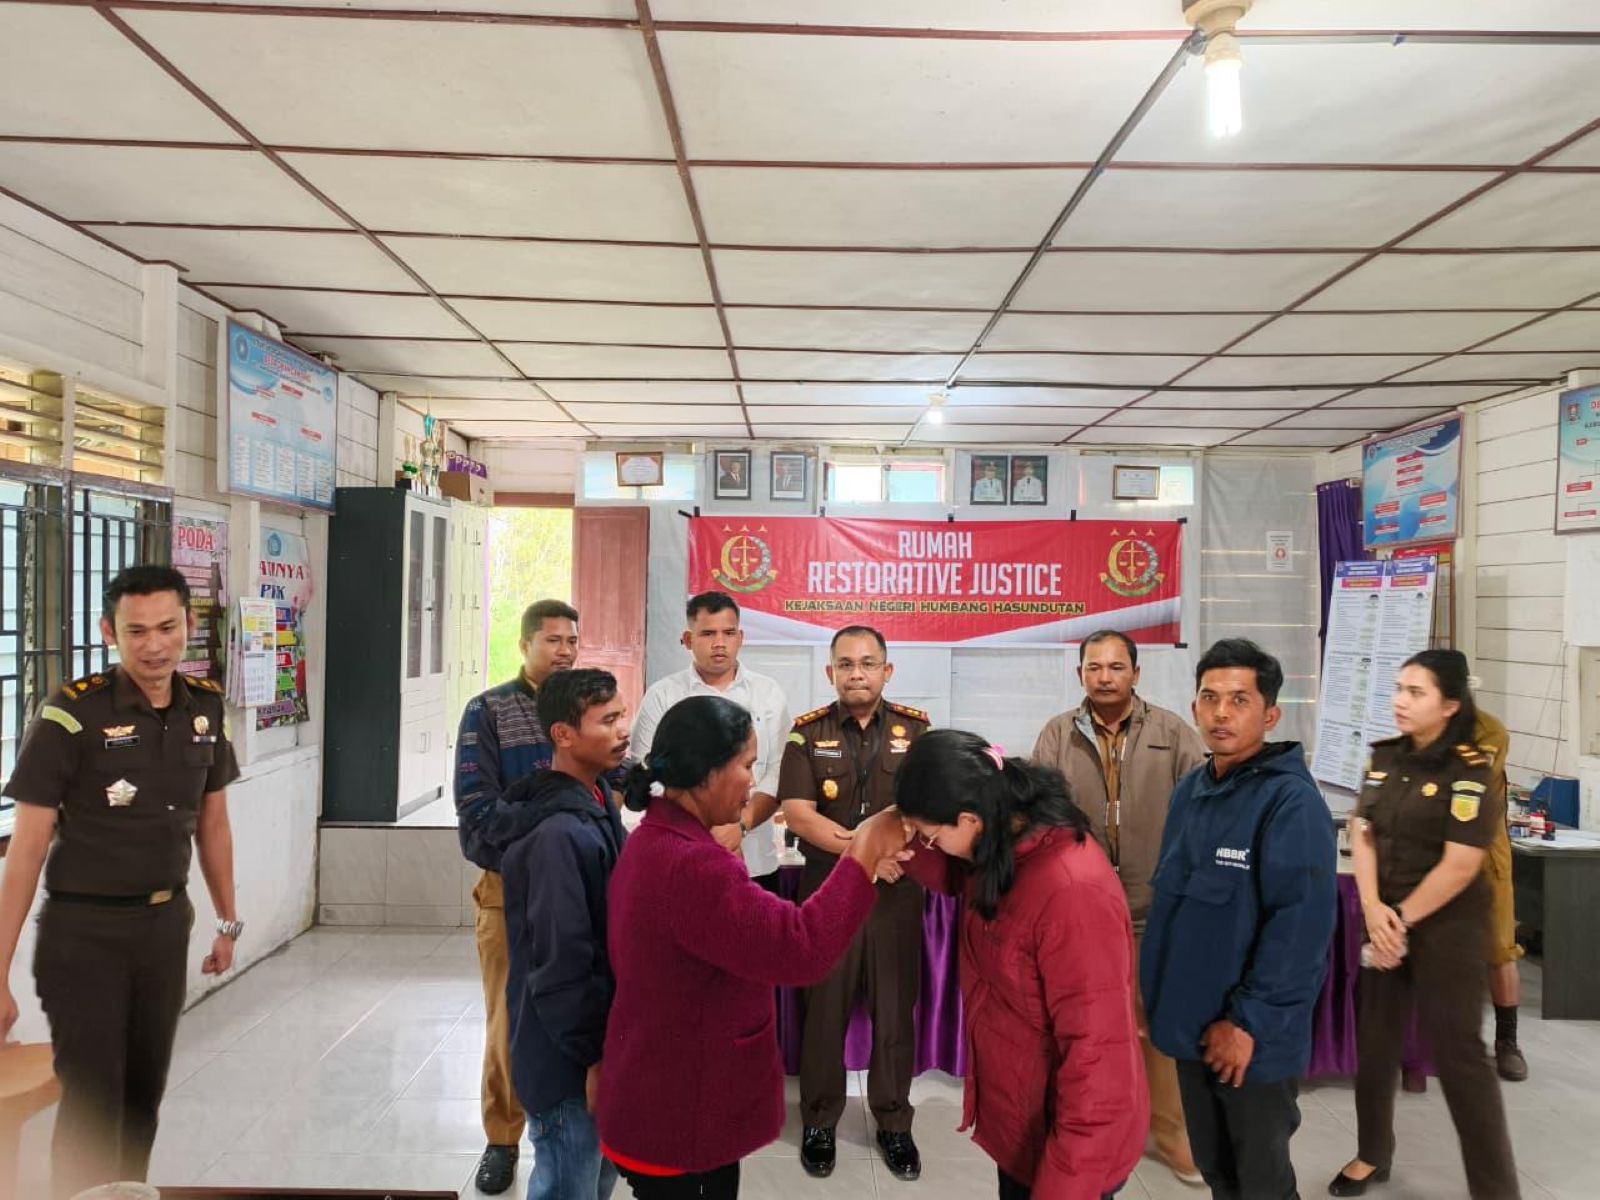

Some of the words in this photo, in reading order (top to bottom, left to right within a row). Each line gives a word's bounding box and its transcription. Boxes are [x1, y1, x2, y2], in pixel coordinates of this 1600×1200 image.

[177, 526, 214, 550] PODA
[899, 531, 973, 559] RUMAH
[808, 561, 962, 596] RESTORATIVE
[969, 563, 1062, 596] JUSTICE
[785, 600, 863, 612] KEJAKSAAN
[869, 601, 916, 613] NEGERI
[920, 601, 988, 613] HUMBANG
[993, 601, 1085, 614] HASUNDUTAN
